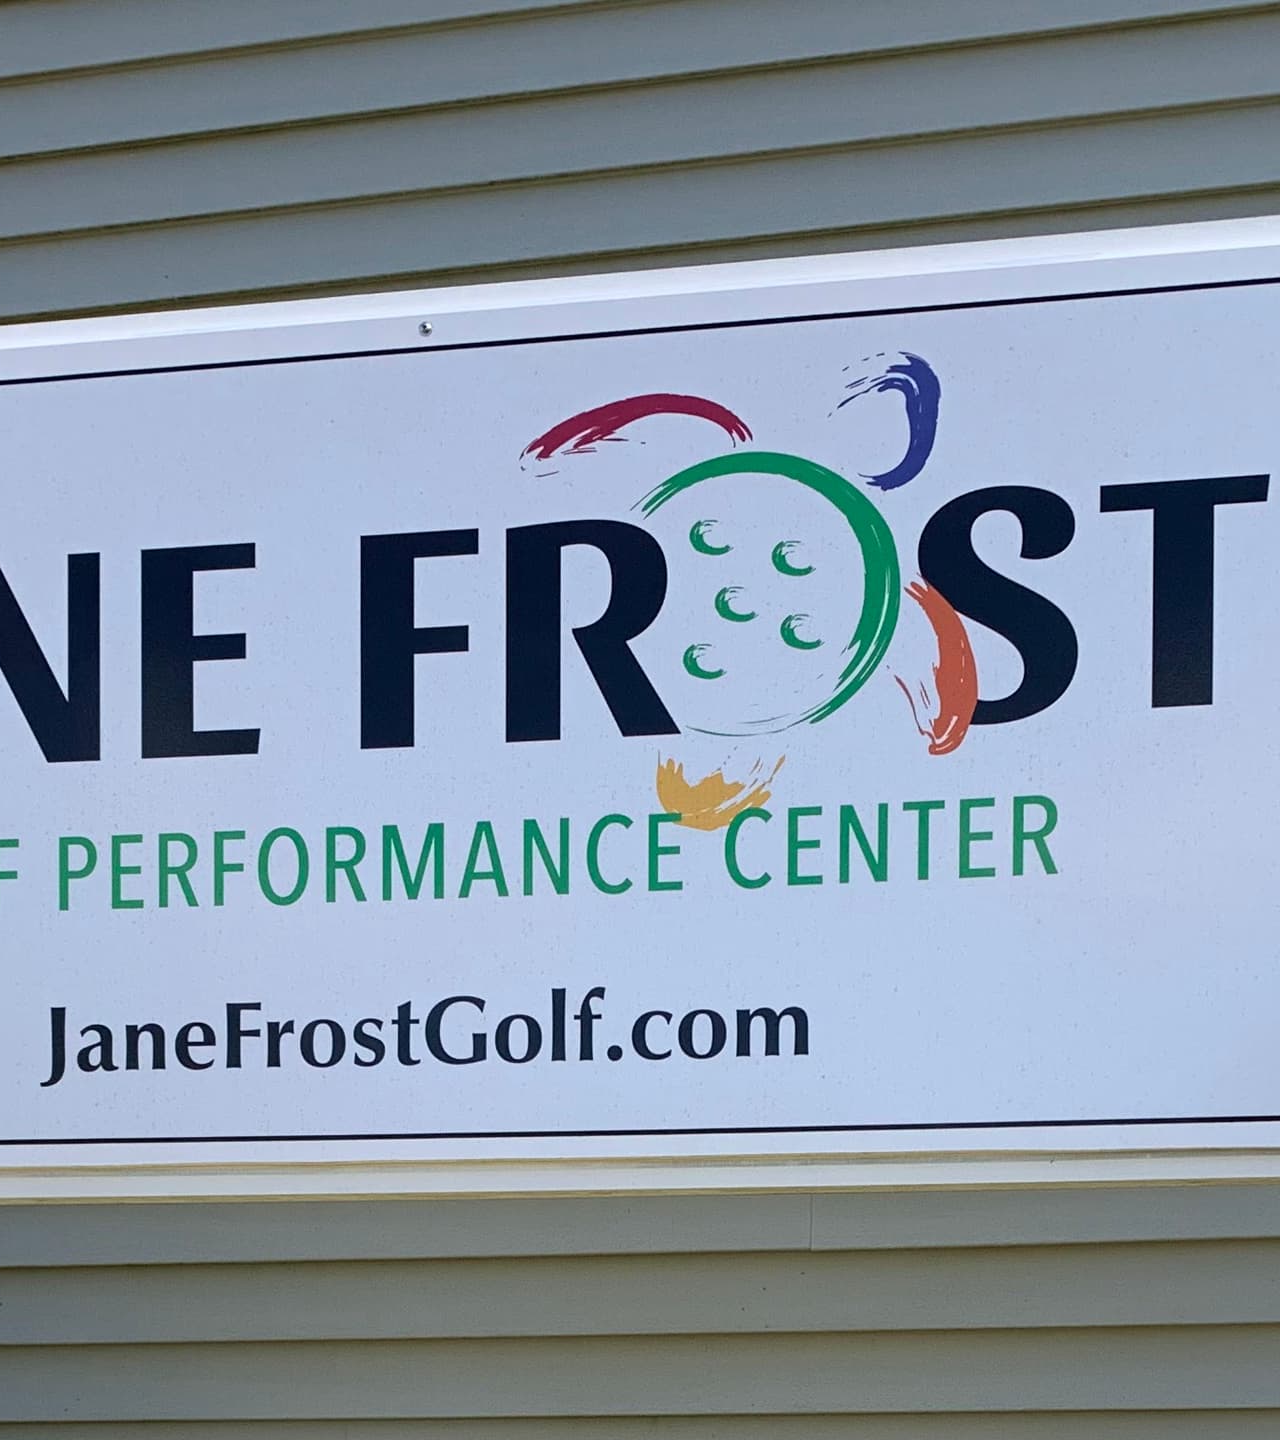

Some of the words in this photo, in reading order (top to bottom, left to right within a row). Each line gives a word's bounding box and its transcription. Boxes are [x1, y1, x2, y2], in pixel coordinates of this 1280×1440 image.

[360, 454, 1271, 750] FROST
[58, 812, 682, 911] PERFORMANCE
[724, 795, 1059, 889] CENTER
[39, 986, 809, 1088] JaneFrostGolf.com
